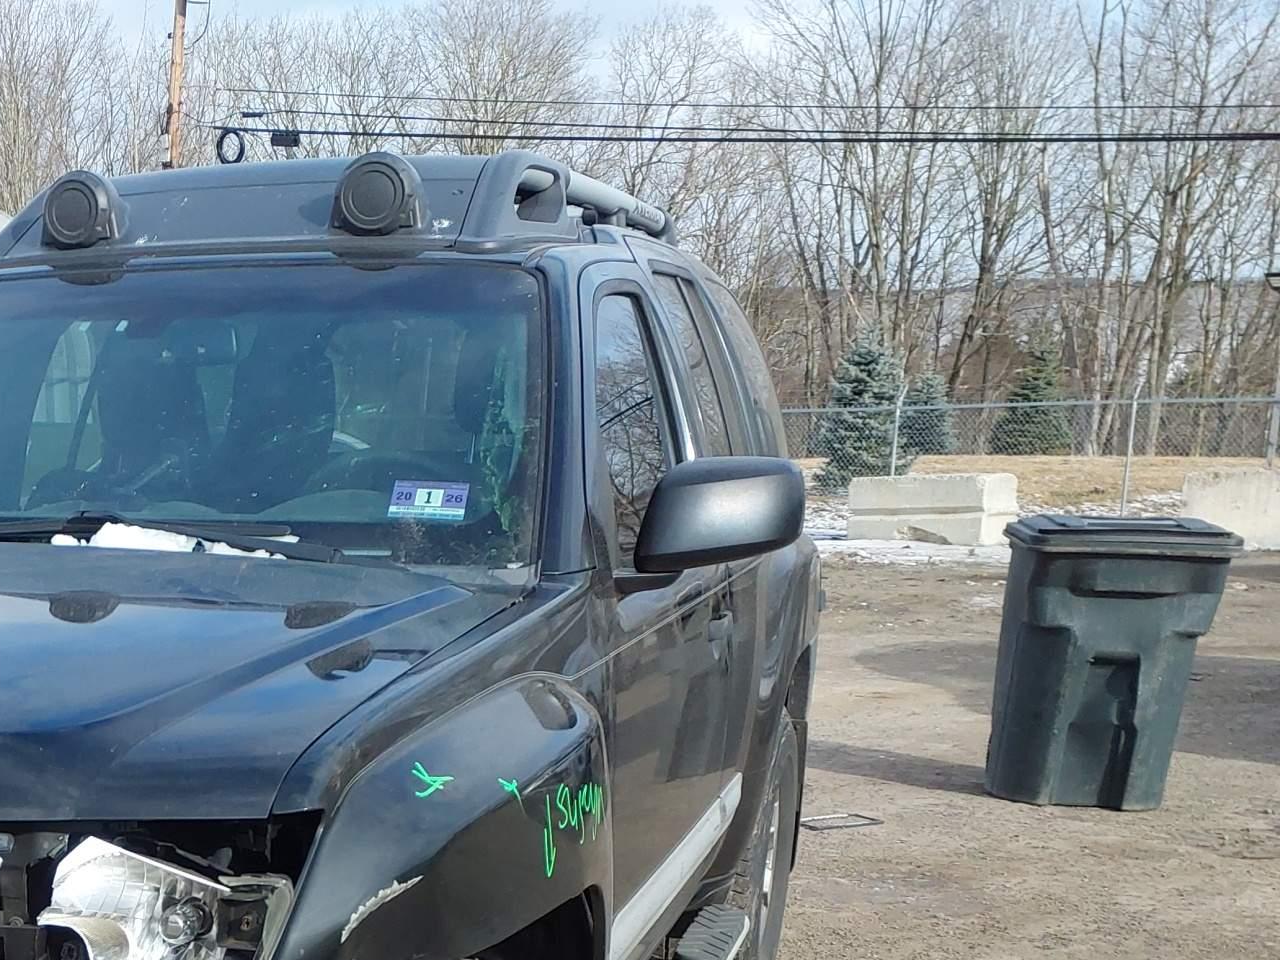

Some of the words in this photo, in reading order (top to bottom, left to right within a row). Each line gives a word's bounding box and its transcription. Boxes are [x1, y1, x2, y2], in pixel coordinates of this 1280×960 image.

[396, 491, 412, 501] 20
[424, 491, 432, 504] 1
[445, 494, 463, 503] 26
